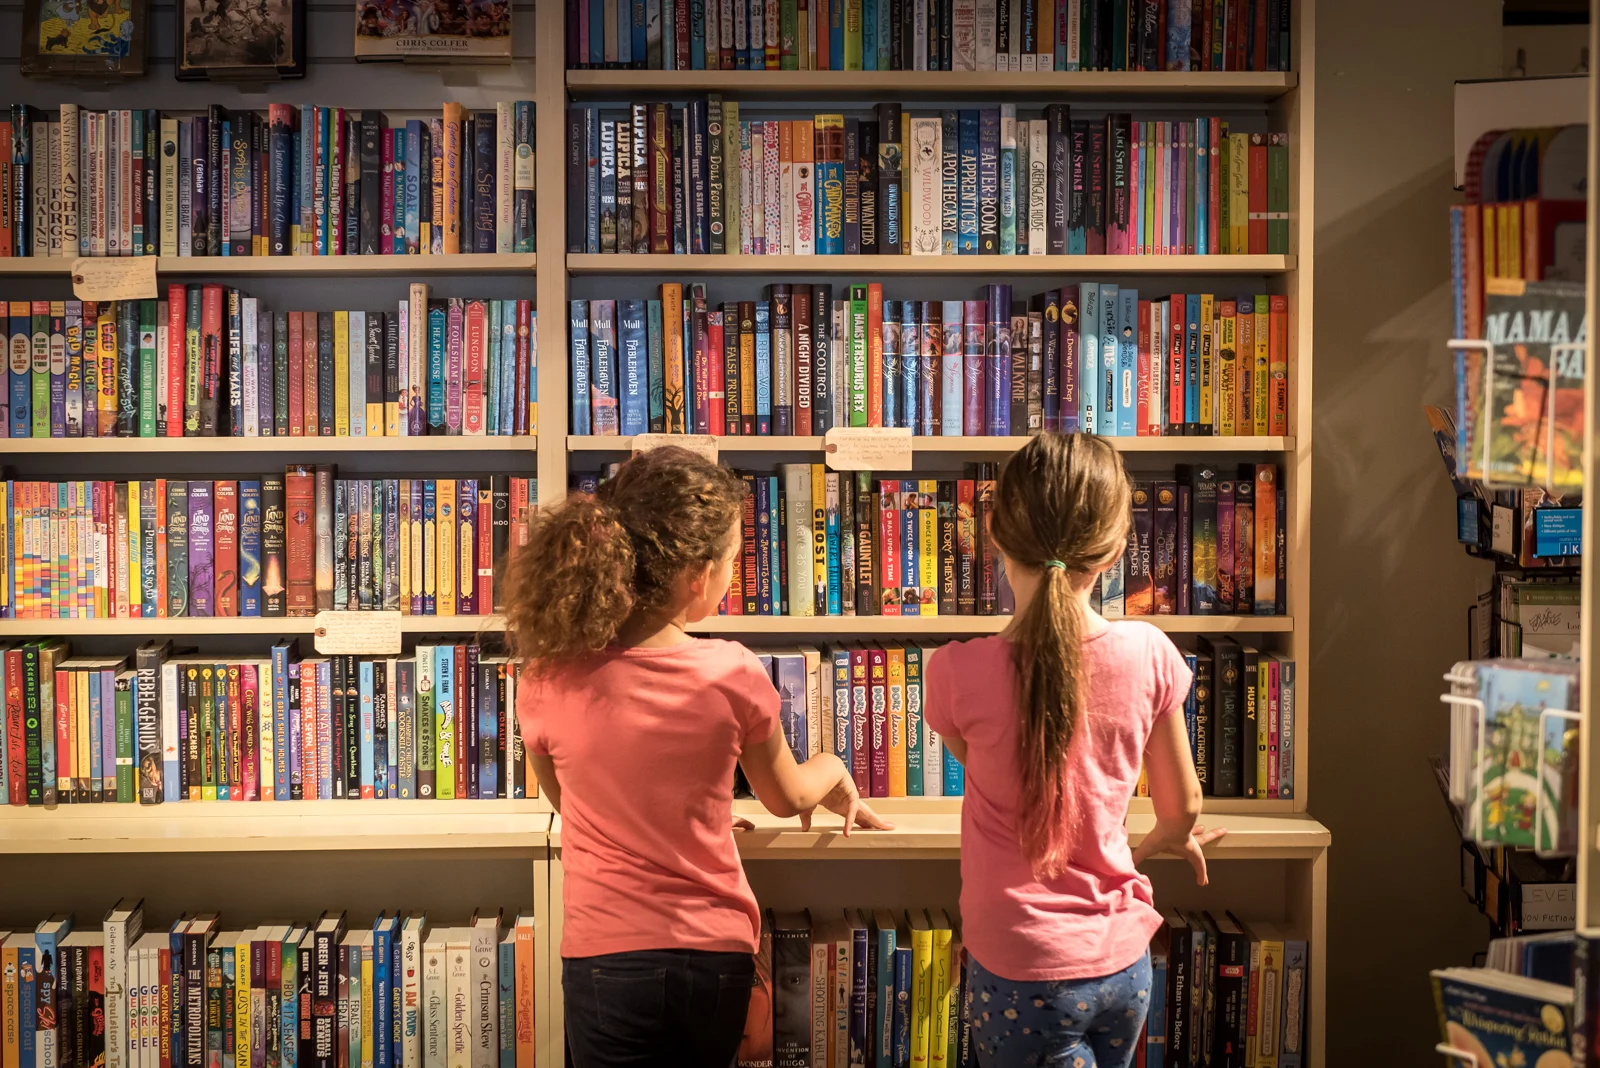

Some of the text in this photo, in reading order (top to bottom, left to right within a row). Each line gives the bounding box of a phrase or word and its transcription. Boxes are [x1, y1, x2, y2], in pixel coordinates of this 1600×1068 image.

[602, 121, 613, 177] LUPICA
[617, 122, 629, 178] LUPICA
[634, 105, 646, 167] LUPICA
[194, 159, 205, 193] Crenshaw
[406, 175, 417, 211] SOAR
[433, 158, 442, 226] CIRCUS MIRANDUS
[711, 156, 721, 217] DOLL PEOPLE
[846, 170, 858, 223] FIREFLY HOLLOW
[922, 167, 932, 225] WILDWOOD
[943, 152, 957, 232] APOTHECARY
[961, 154, 976, 233] APPRENTICES
[981, 153, 995, 235] AFTER-ROOM
[1031, 161, 1045, 231] GREENGLASS HOUSE
[64, 173, 77, 242] ASHES
[315, 196, 324, 214] TWO
[888, 221, 898, 244] QUESTS
[230, 329, 240, 354] LIFE
[594, 320, 610, 328] Mull
[623, 320, 639, 328] Mull
[799, 333, 808, 363] NIGHT
[1486, 310, 1571, 344] MAMA
[68, 327, 81, 390] BAD MAGIC
[85, 330, 96, 391] BAD LUCK
[102, 323, 114, 396] BAD NEWS
[432, 327, 440, 379] HEAP HOUSE
[451, 325, 459, 378] FOULSHAM
[575, 339, 586, 394] FABLEHAVEN
[597, 341, 609, 395] FABLEHAVEN
[627, 340, 638, 395] FABLEHAVEN
[816, 342, 826, 398] SCOURGE
[855, 314, 864, 412] HAMSTERSAURUS REX
[1012, 352, 1024, 402] VALKYRIE
[231, 371, 240, 406] MARS
[727, 347, 737, 413] FALSE PRINCE
[799, 367, 808, 408] DIVIDED
[815, 509, 824, 565] GHOST
[860, 531, 872, 585] GAUNTLET
[942, 522, 955, 593] STORY THIEVES
[1130, 543, 1138, 576] HADES
[1140, 546, 1150, 577] HOUSE
[1562, 545, 1579, 554] J K
[145, 530, 154, 598] PEDDLER'S ROAD
[319, 685, 329, 711] BETTER
[421, 696, 429, 726] SNAKES
[873, 686, 884, 749] DORK diaries
[890, 686, 900, 747] DORK diaries
[1247, 687, 1255, 720] HUSKY
[319, 713, 329, 741] NATE
[421, 734, 429, 765] STONES
[1196, 716, 1207, 783] BLACKTHORN KEY
[1542, 914, 1575, 922] FICTION
[41, 982, 51, 1003] spy
[319, 938, 328, 995] GREEN JETER
[1175, 976, 1184, 1001] Ethan
[6, 983, 14, 1014] space
[24, 983, 33, 1051] spaced out
[238, 990, 248, 1014] LOST
[301, 994, 310, 1039] HOME RUN
[405, 1010, 416, 1037] DRUMS
[406, 991, 416, 1006] AM
[479, 982, 492, 1048] Crimson Skew
[815, 977, 825, 1063] SHOOTING KABUL
[935, 959, 946, 1051] SHORT
[44, 1031, 54, 1068] school
[188, 987, 201, 1064] METROPOLITANS
[429, 996, 440, 1055] Glass Sentence
[1174, 1021, 1182, 1049] Before
[238, 1044, 248, 1066] SUN
